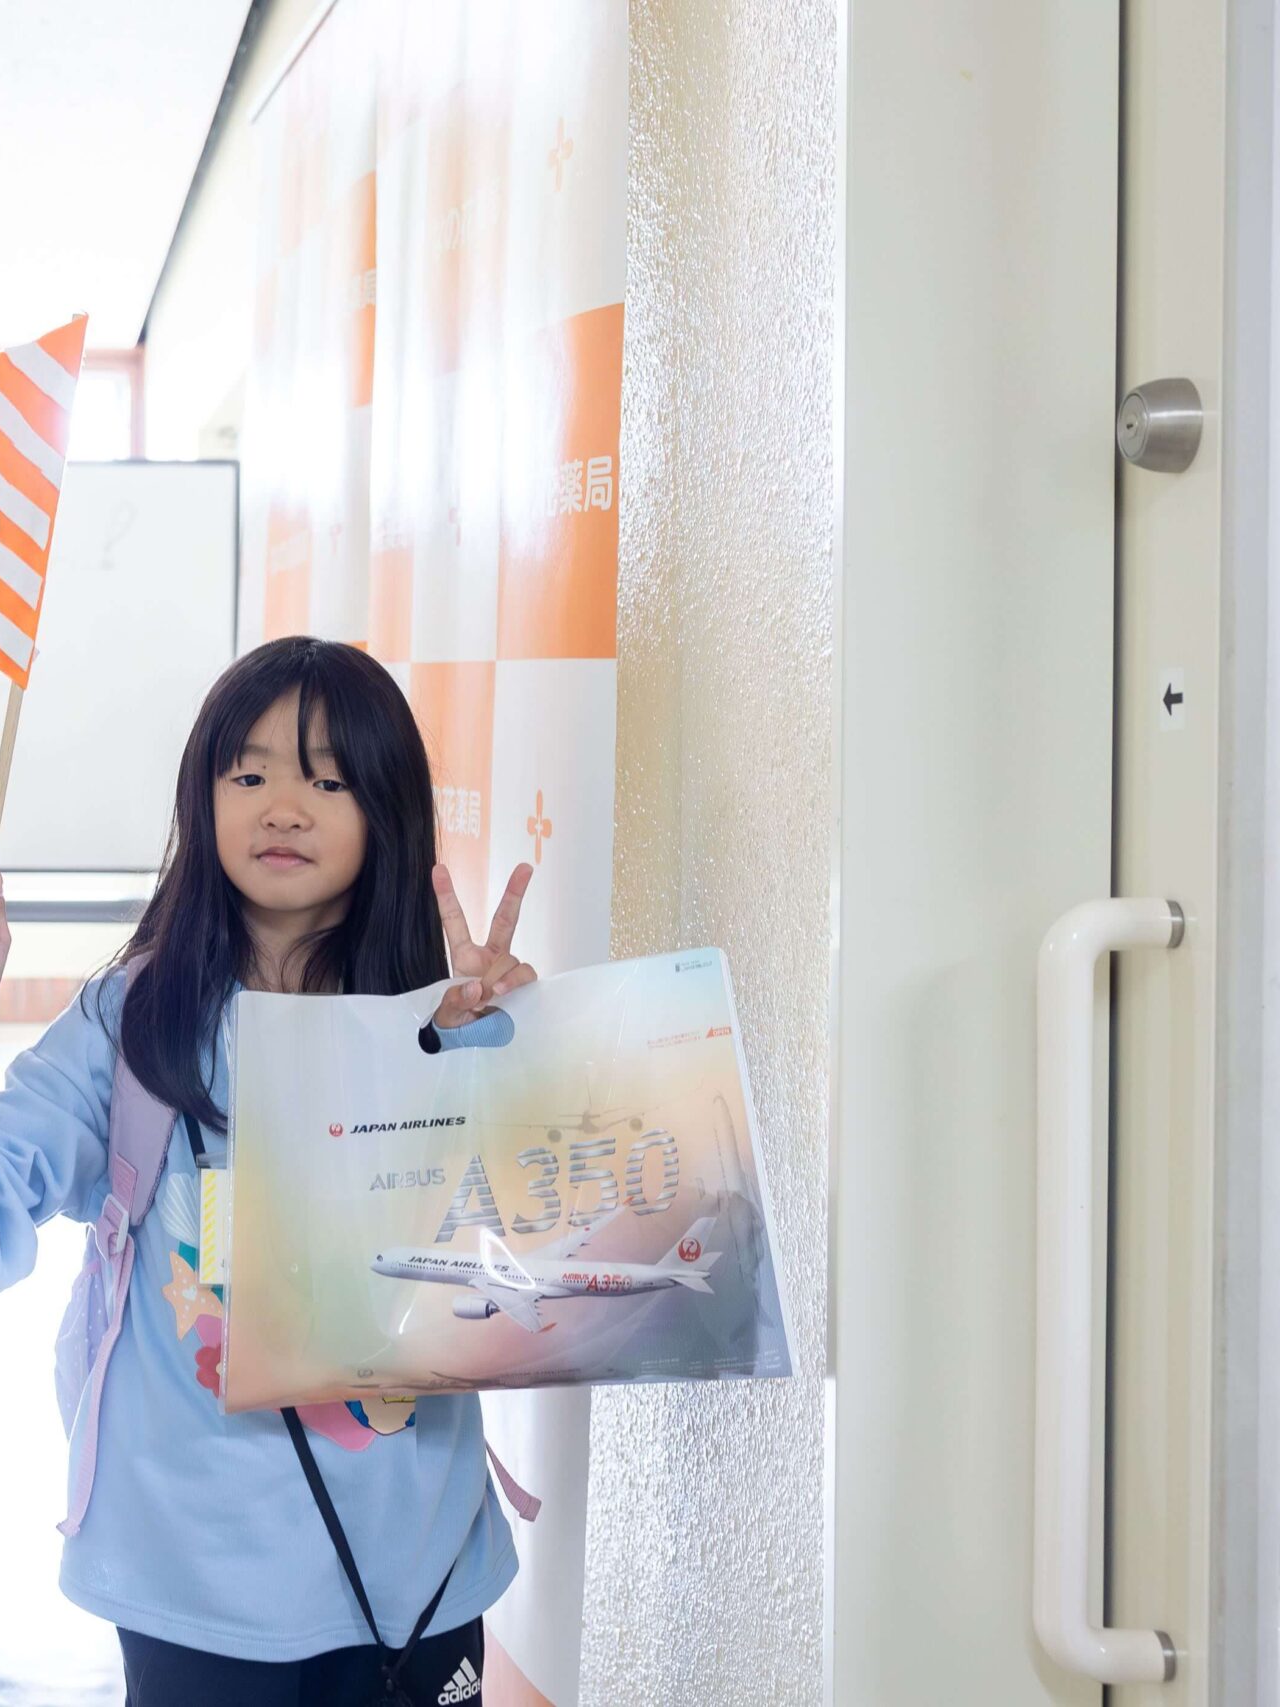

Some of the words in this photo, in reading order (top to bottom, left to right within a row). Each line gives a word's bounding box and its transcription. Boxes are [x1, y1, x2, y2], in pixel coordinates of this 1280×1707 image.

[350, 1122, 397, 1134] JAPAN
[399, 1115, 467, 1131] AIRLINES
[369, 1167, 446, 1191] AIRBUS
[433, 1128, 680, 1243] A350
[407, 1256, 448, 1266] JAPAN
[450, 1261, 510, 1272] AIRLIES
[586, 1273, 632, 1292] A350
